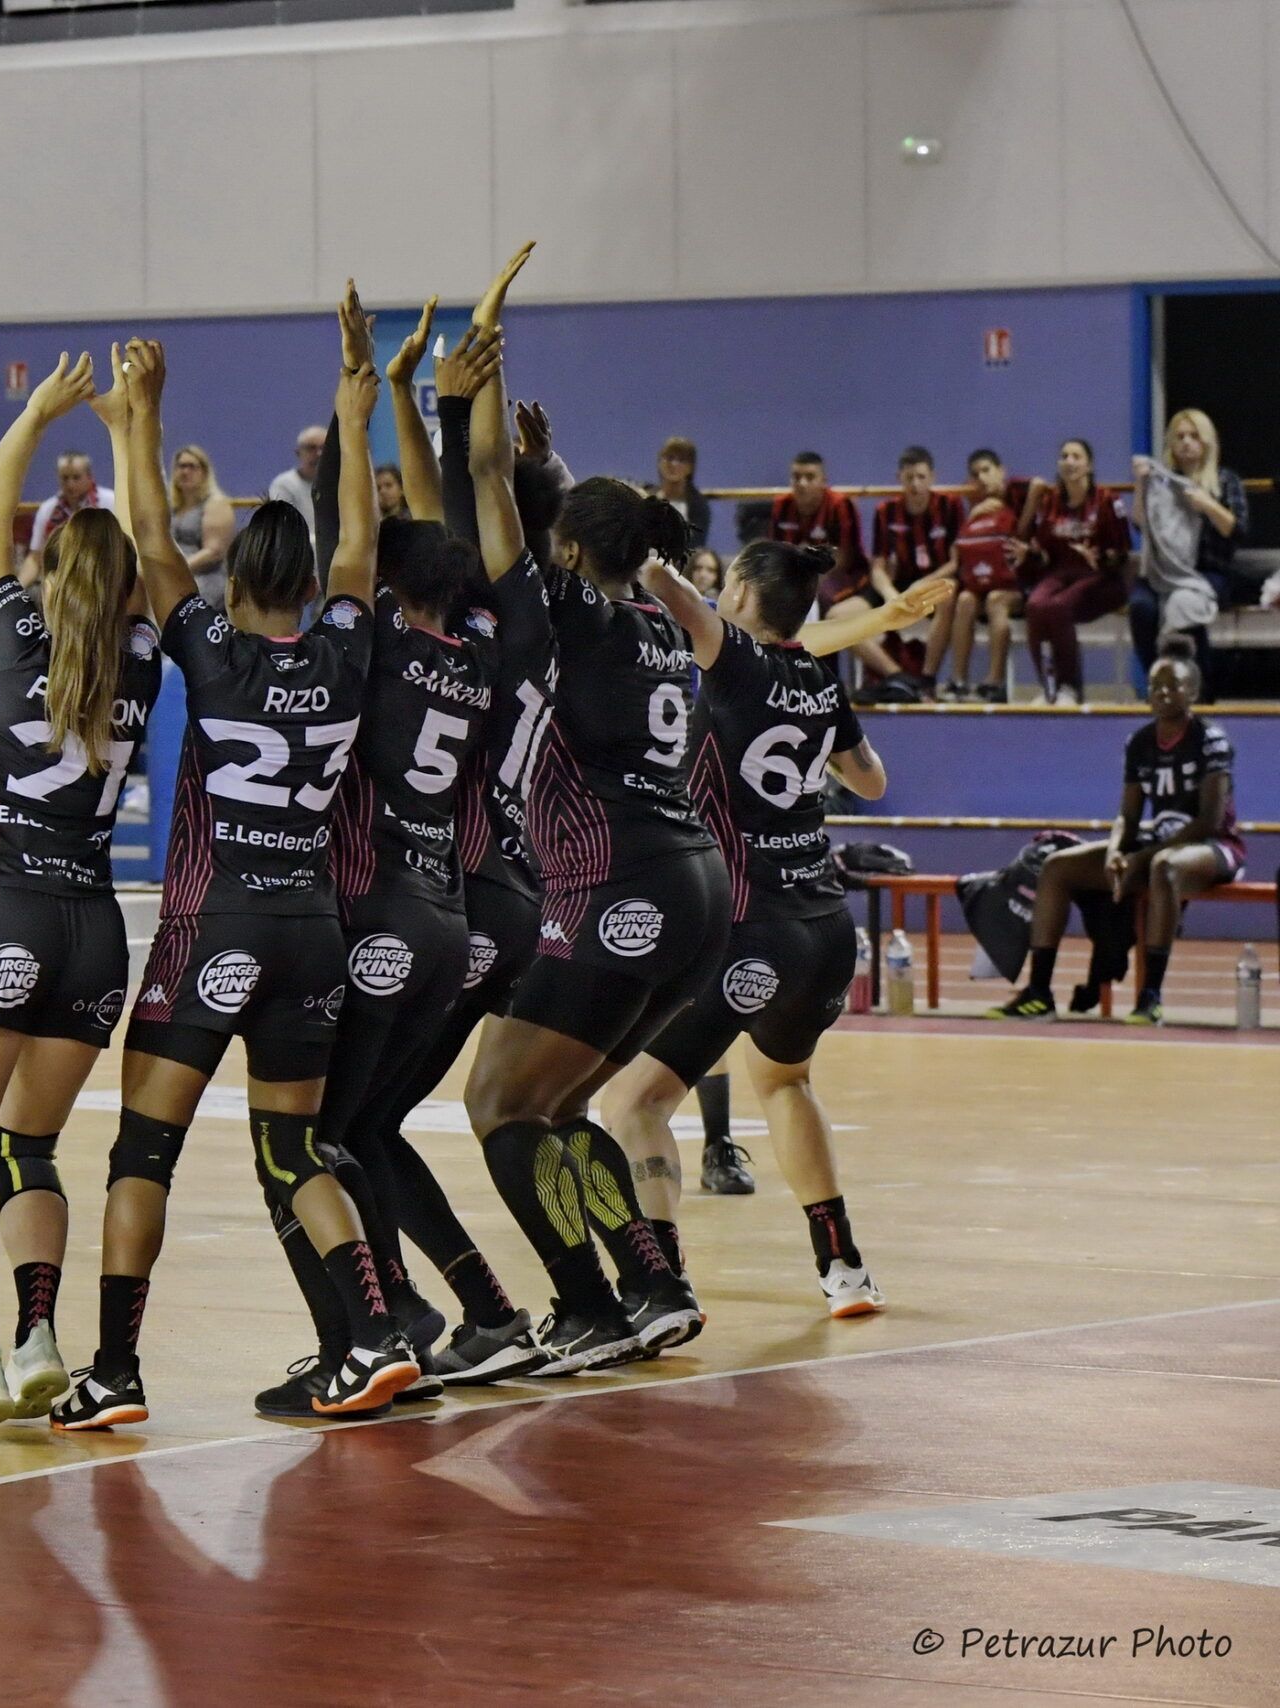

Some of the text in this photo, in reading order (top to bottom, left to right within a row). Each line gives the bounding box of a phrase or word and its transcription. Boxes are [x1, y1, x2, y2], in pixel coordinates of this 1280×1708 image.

[263, 685, 330, 714] RIZO
[643, 682, 688, 767] 9
[403, 707, 470, 794] 5
[198, 712, 361, 812] 23
[739, 724, 837, 810] 64
[215, 821, 312, 852] E.Leclerc
[607, 912, 664, 926] BURGER
[603, 922, 662, 940] KING
[356, 948, 414, 964] BURGER
[205, 964, 262, 981] BURGER
[352, 959, 412, 979] KING
[731, 970, 780, 988] BURGER
[203, 976, 259, 997] KING
[727, 980, 776, 1001] KING
